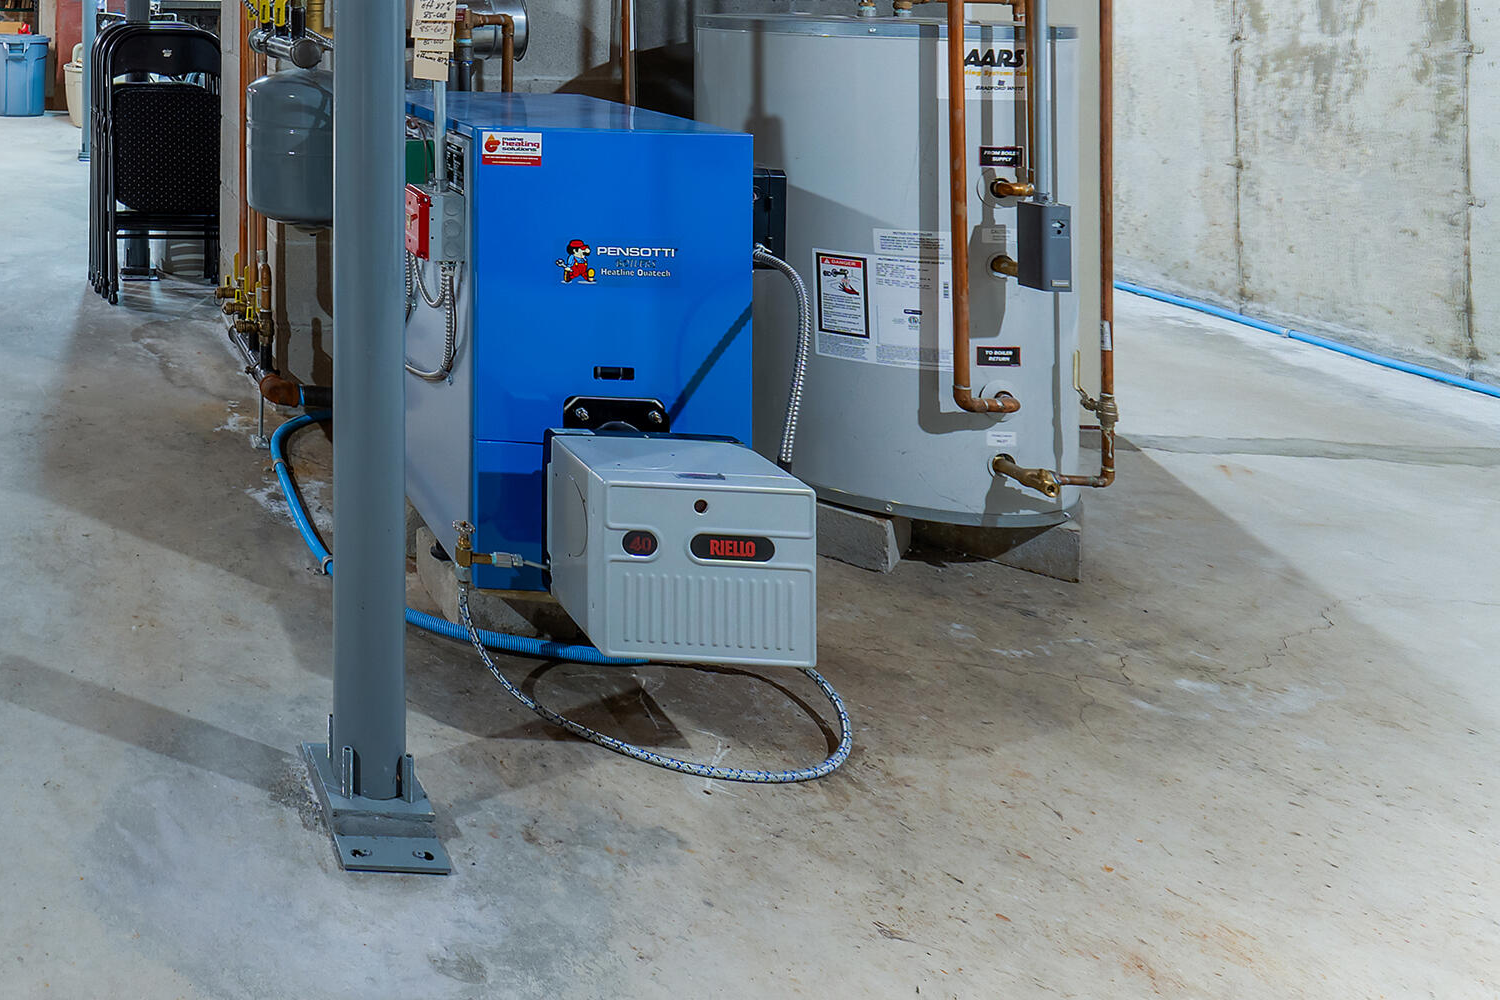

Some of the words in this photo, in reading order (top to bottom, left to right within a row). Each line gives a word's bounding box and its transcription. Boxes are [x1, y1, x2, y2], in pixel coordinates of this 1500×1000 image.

[964, 48, 1026, 68] AARS
[501, 140, 540, 149] heating
[596, 246, 675, 258] PENSOTTI
[615, 259, 657, 268] BOILERS
[600, 268, 635, 277] Heatline
[629, 535, 652, 552] 40
[709, 539, 757, 558] RIELLO
